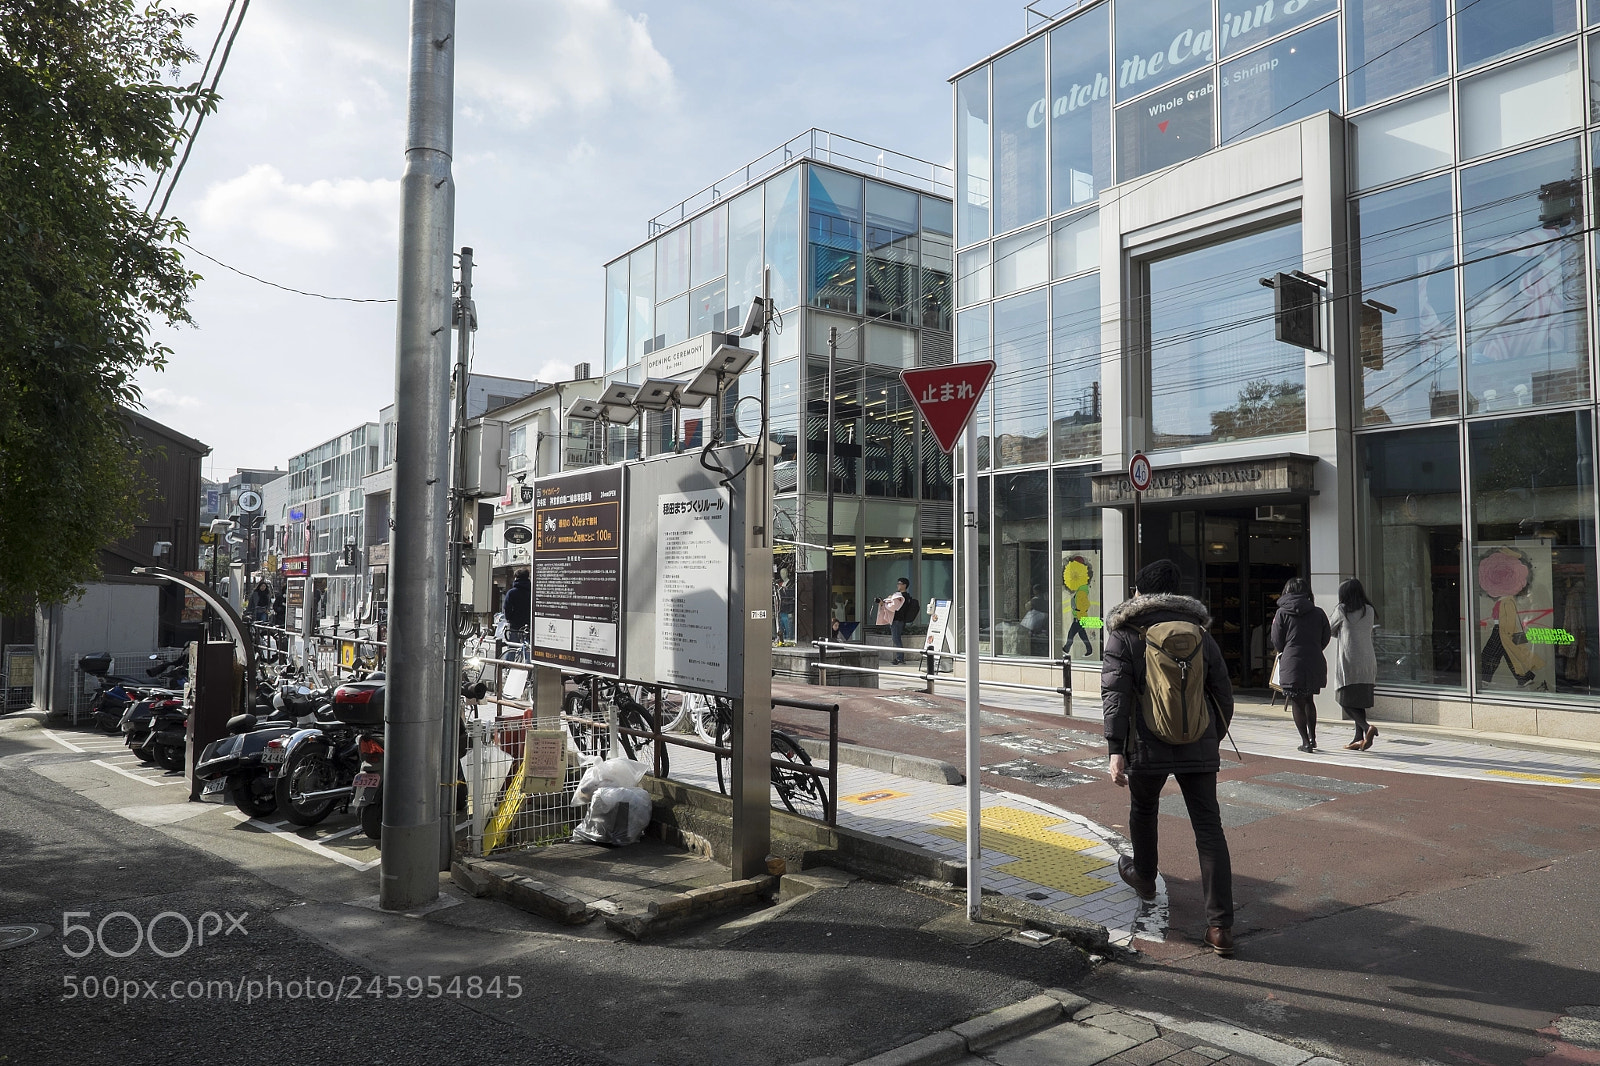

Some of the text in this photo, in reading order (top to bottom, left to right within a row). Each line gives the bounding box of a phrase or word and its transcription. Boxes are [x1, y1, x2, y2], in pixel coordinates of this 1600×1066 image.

[1026, 0, 1276, 129] Catch the Cajun
[1149, 95, 1183, 117] Whole
[1222, 77, 1230, 87] &
[1233, 57, 1279, 84] Shrimp
[672, 345, 703, 361] CEREMONY
[920, 380, 975, 403] 止まれ
[1187, 468, 1262, 491] STANDARD
[1525, 633, 1575, 642] STANDARD
[1526, 627, 1568, 635] JOURNAL
